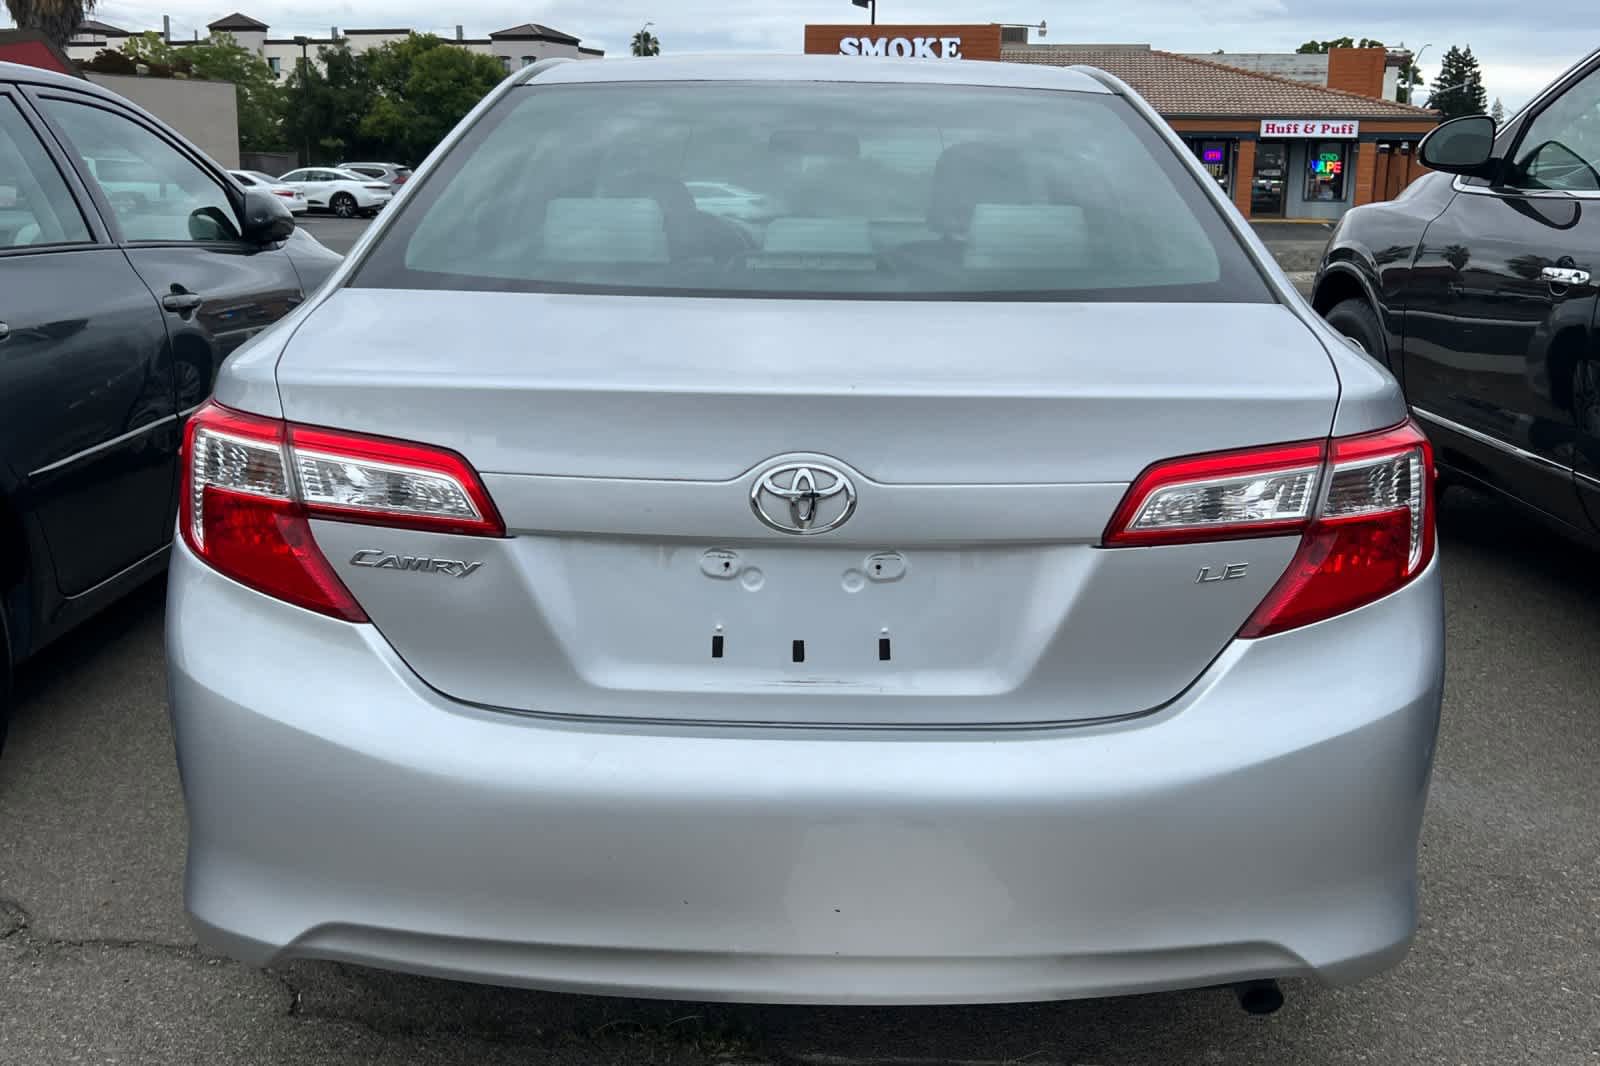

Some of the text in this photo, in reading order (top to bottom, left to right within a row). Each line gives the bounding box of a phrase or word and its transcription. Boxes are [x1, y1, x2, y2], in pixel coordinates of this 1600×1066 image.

[839, 37, 962, 60] SMOKE
[1265, 123, 1355, 134] Huff & Puff
[1311, 160, 1343, 174] VAPE
[349, 548, 483, 578] CAMRY
[1194, 562, 1249, 584] LE
